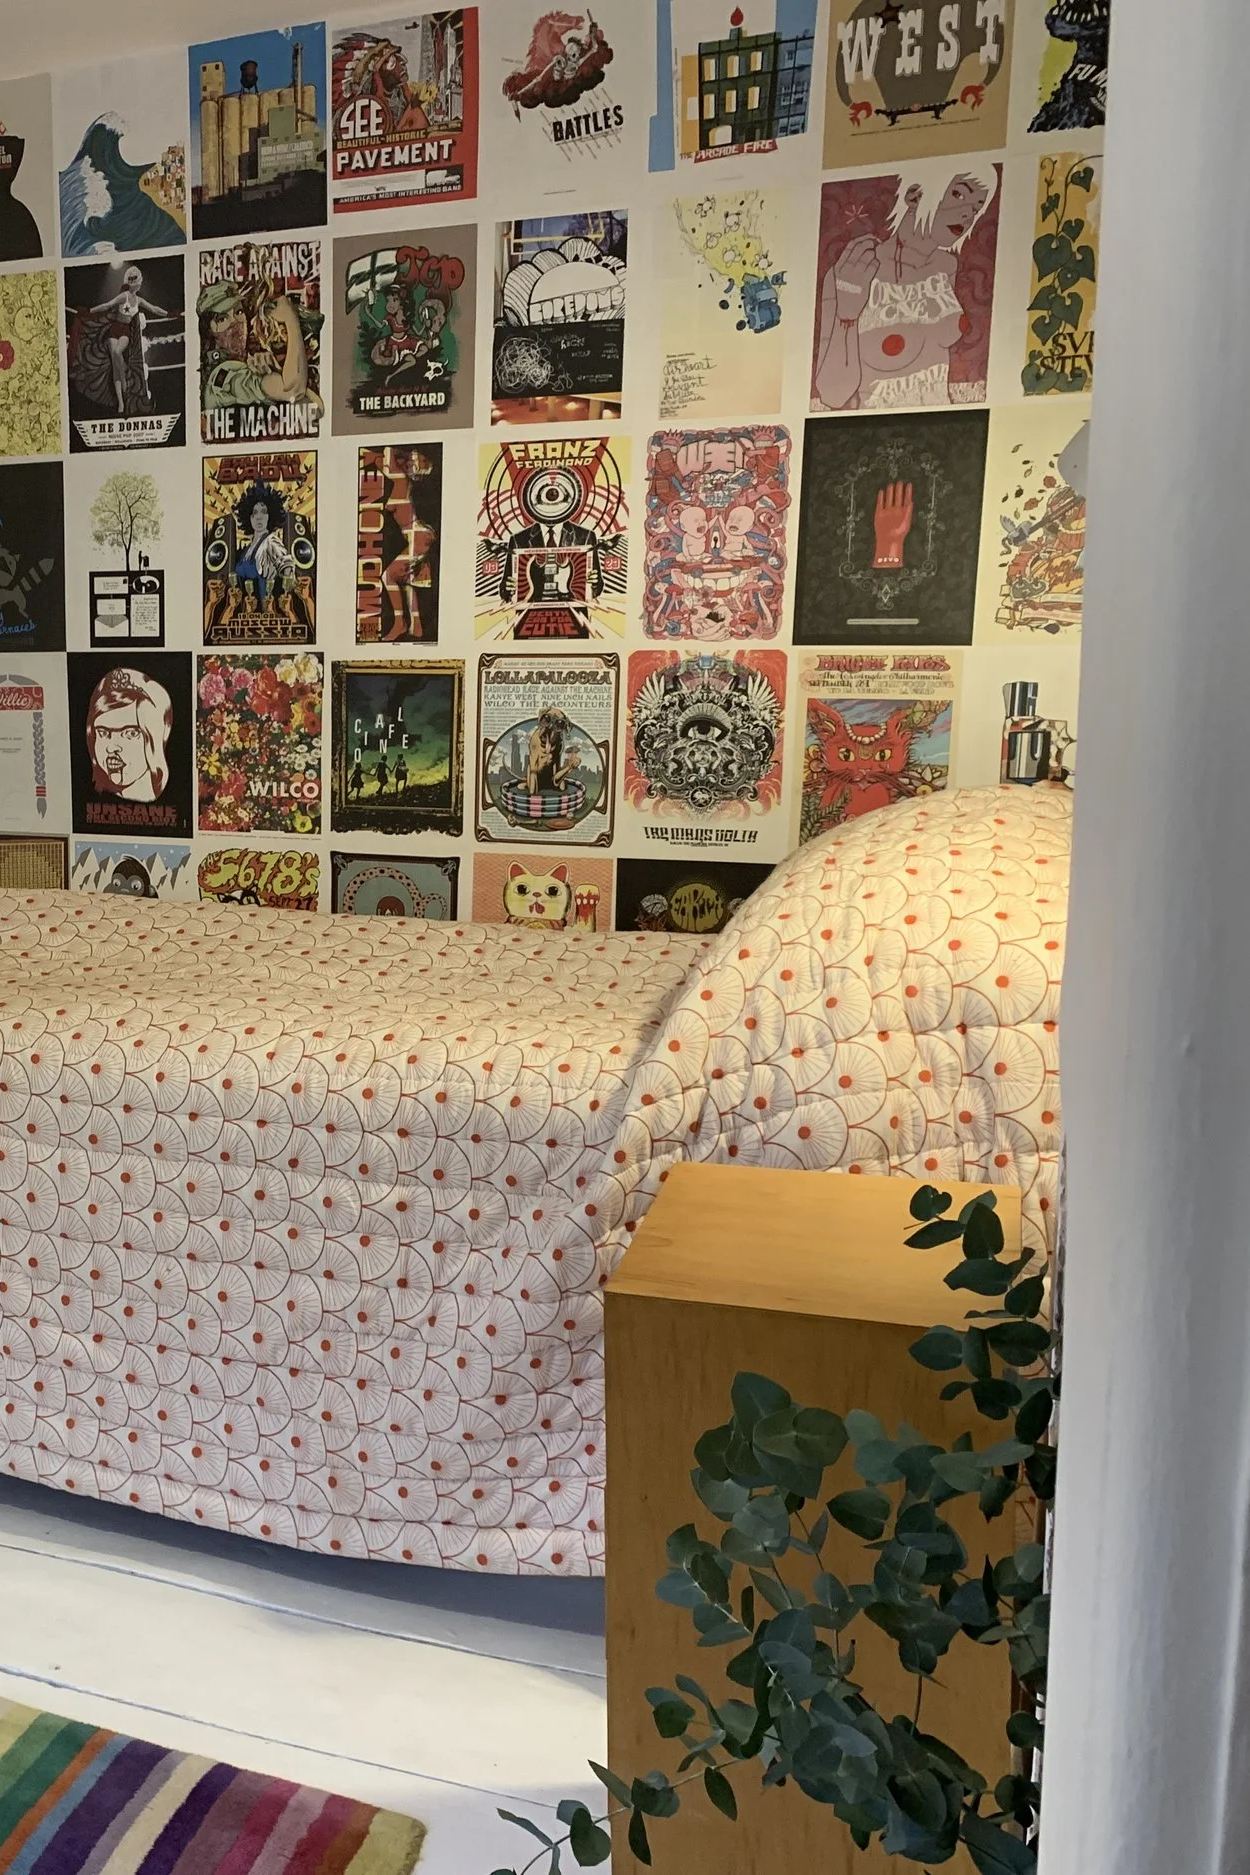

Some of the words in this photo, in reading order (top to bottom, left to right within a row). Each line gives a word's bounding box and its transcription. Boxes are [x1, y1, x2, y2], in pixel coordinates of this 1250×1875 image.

[837, 0, 1005, 83] WEST
[1068, 64, 1097, 80] FU
[340, 99, 383, 140] SEE
[553, 105, 624, 143] BATTLES
[336, 139, 454, 173] PAVEMENT
[696, 145, 739, 159] ARCADE
[743, 139, 774, 153] FIRE
[200, 249, 245, 285] RAGE
[249, 241, 321, 284] AGAINST
[359, 397, 381, 410] THE
[384, 392, 446, 409] BACKYARD
[91, 423, 114, 434] THE
[118, 419, 163, 432] DONNAS
[203, 408, 237, 440] THE
[240, 403, 319, 440] MACHINE
[508, 439, 602, 464] FRANZ
[515, 456, 594, 469] FERDINAND
[228, 618, 293, 628] MOSCOW
[485, 670, 612, 685] LOLLAPALOOZA
[250, 781, 319, 798] WILCO
[86, 803, 177, 817] UNSANE
